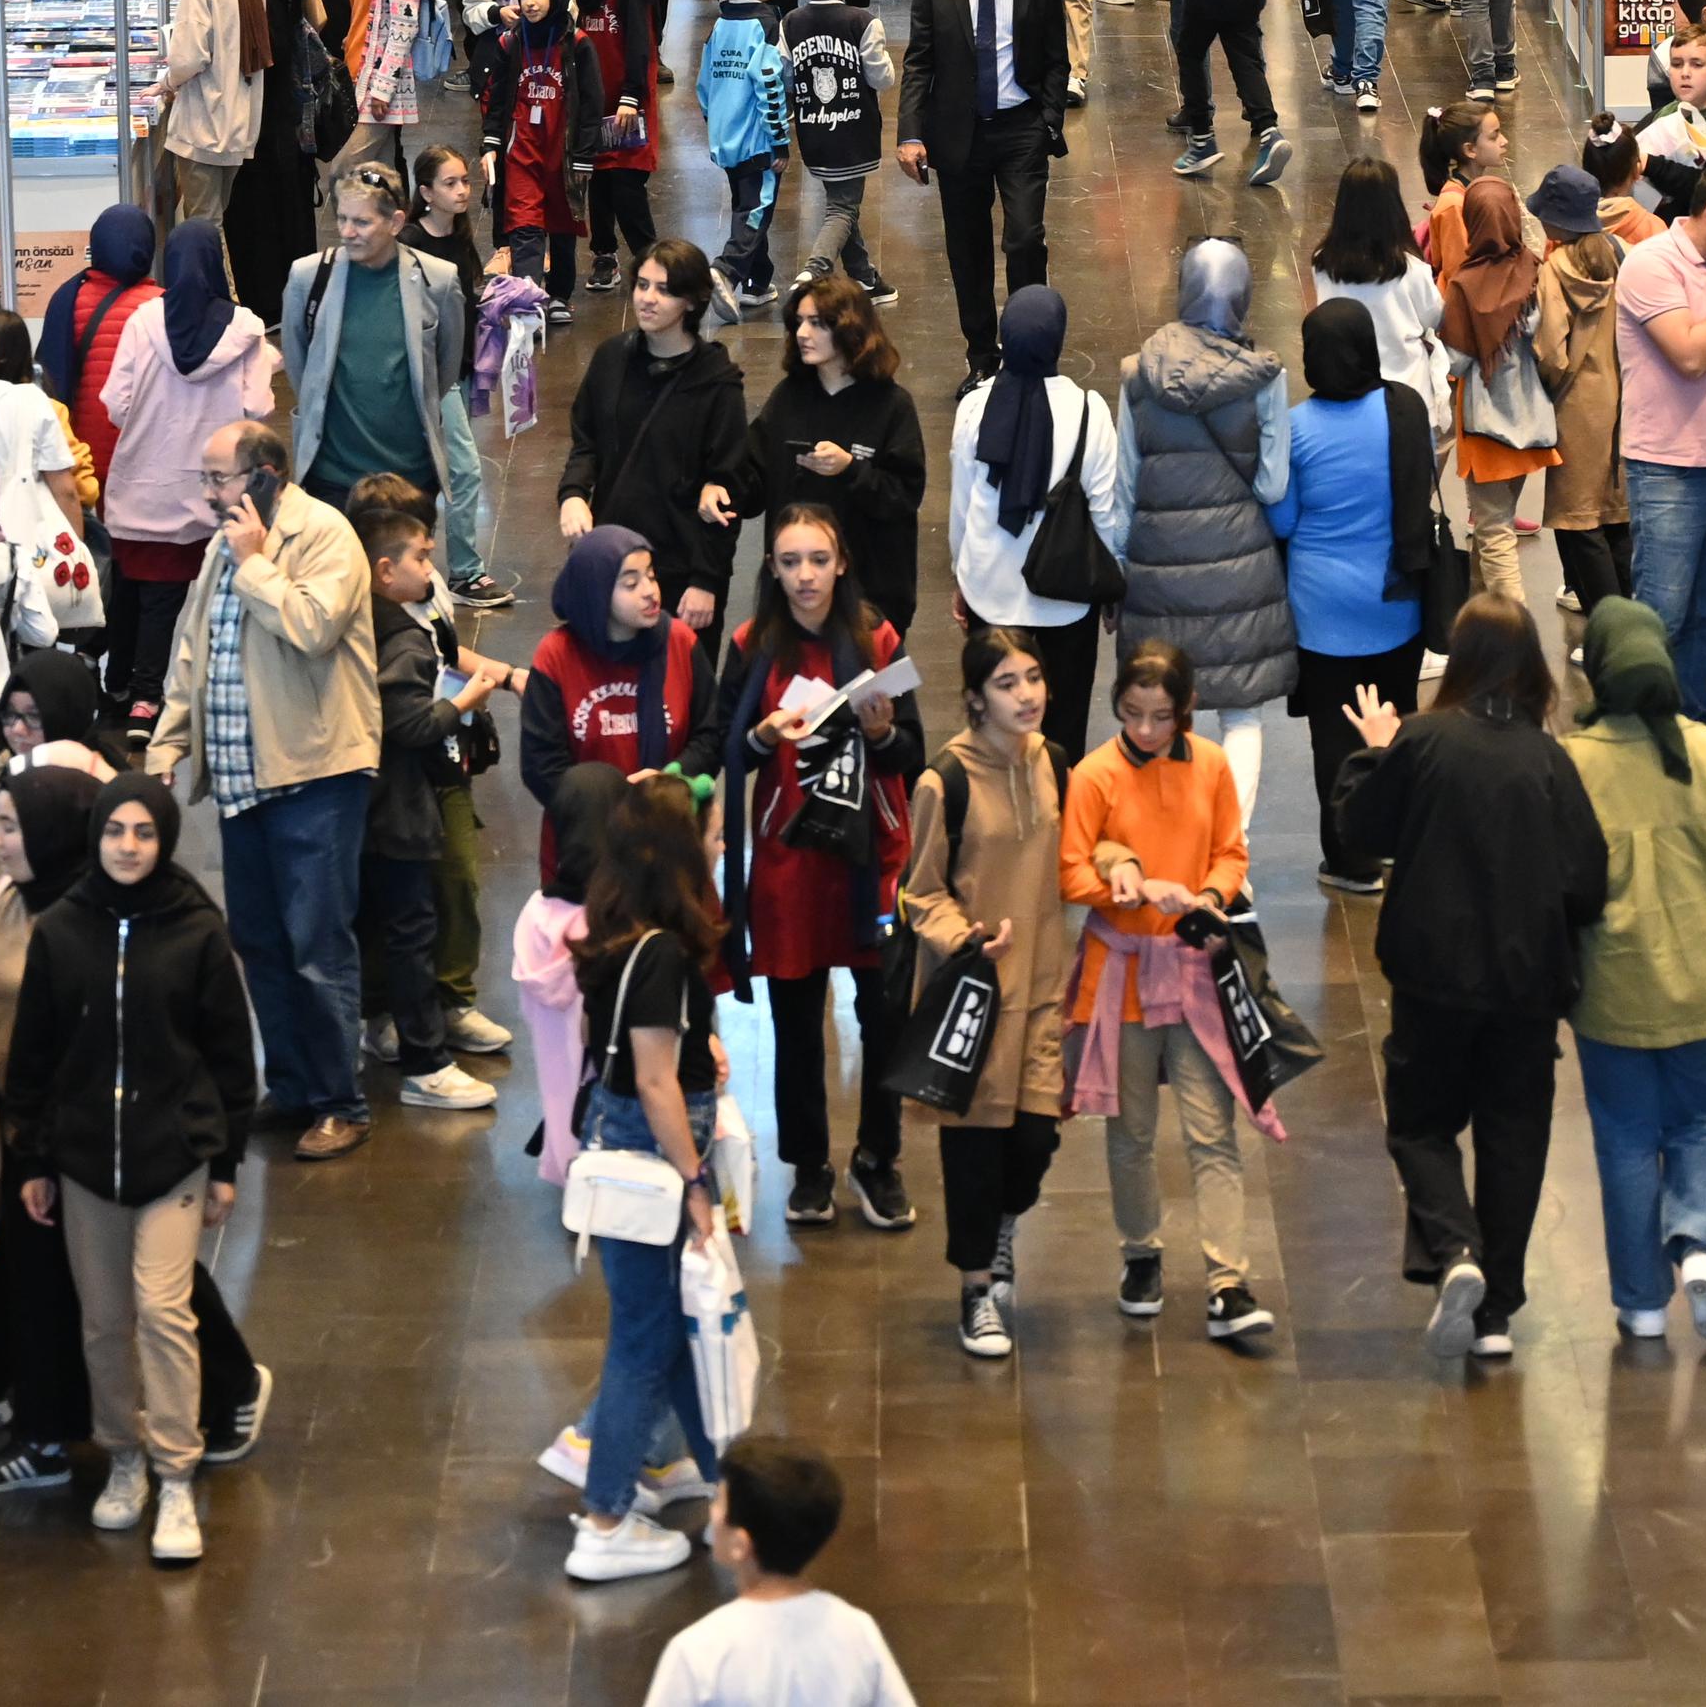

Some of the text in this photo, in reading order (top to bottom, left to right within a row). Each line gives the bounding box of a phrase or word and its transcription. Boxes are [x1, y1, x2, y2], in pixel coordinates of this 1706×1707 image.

[1619, 3, 1675, 23] kitap
[1619, 21, 1675, 38] günleri
[792, 35, 860, 67] EGENDARY
[795, 82, 808, 94] 19
[799, 105, 862, 132] Los Angeles
[33, 245, 74, 256] önsözü
[15, 258, 54, 272] nsan
